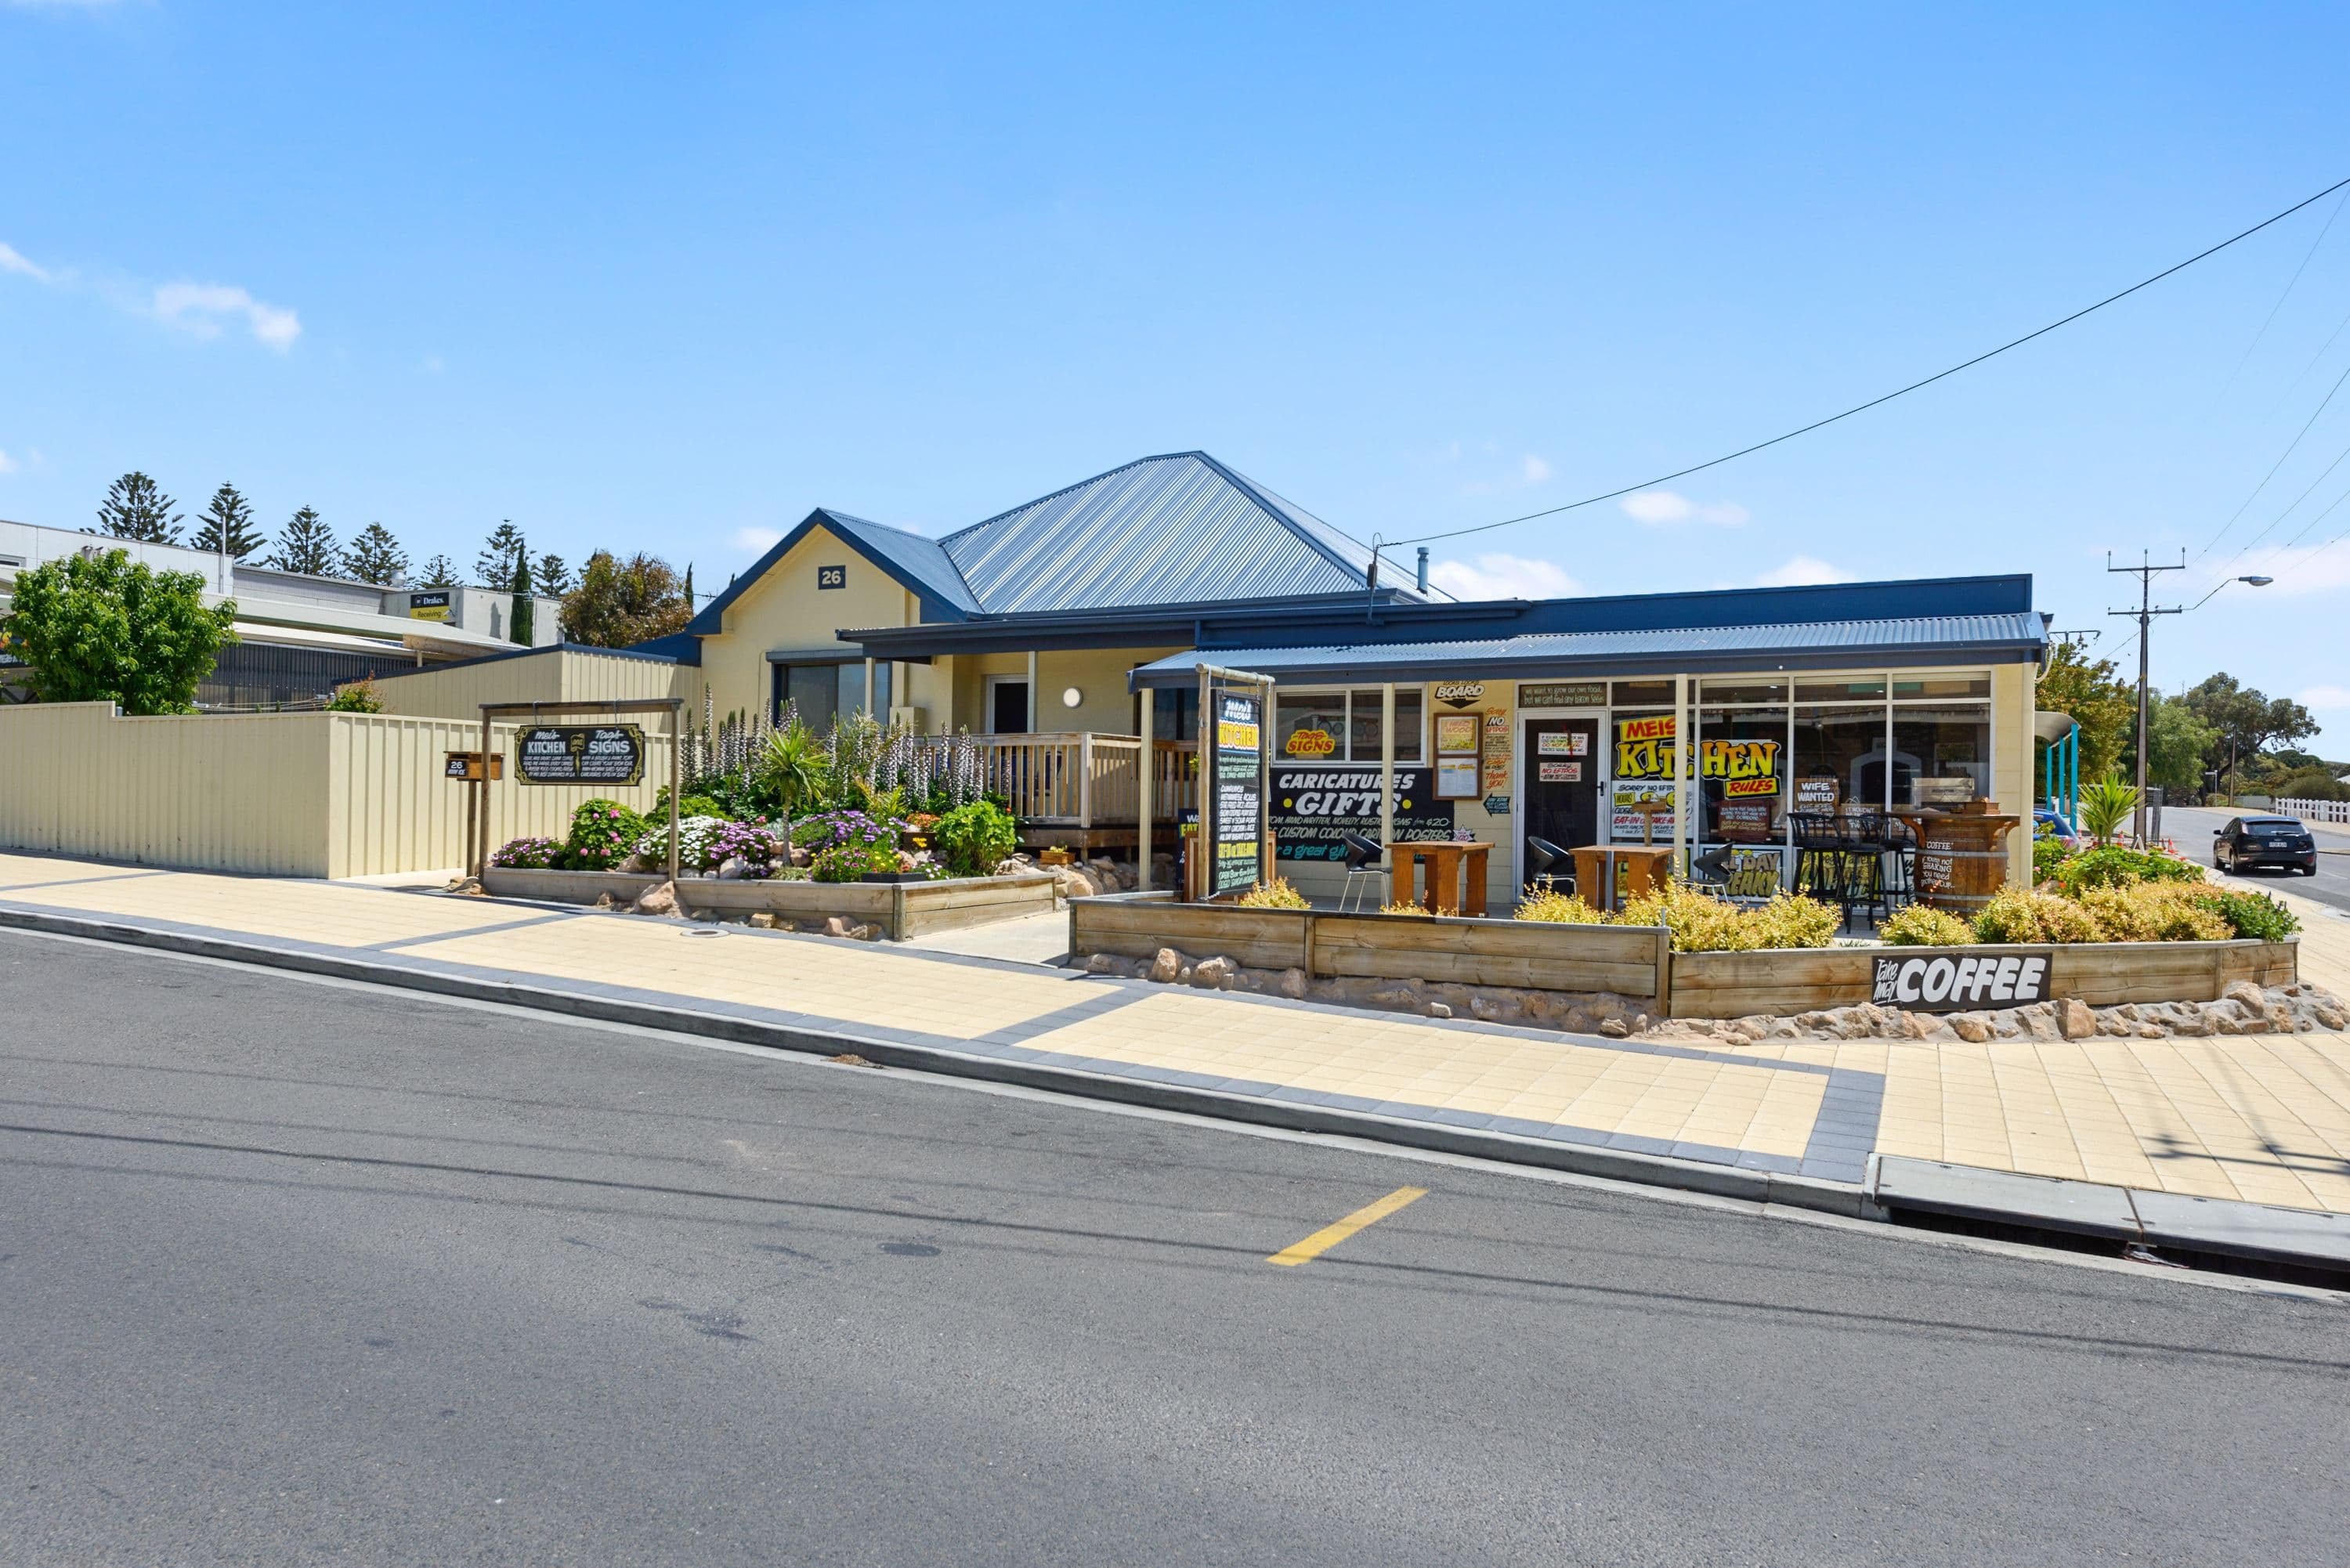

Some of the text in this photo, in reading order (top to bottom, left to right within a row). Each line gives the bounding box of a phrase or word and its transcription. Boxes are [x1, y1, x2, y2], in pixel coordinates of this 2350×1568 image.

[822, 570, 841, 584] 26
[423, 596, 444, 605] Drakes
[1434, 685, 1485, 699] BOARD
[1487, 717, 1505, 726] NO
[1218, 721, 1259, 750] KITCHEN
[527, 741, 566, 754] KITCHEN
[589, 740, 630, 754] SIGNS
[1287, 740, 1333, 752] SIGNS
[1278, 774, 1415, 789] CARICATURES
[1730, 779, 1773, 793] RULES
[1802, 782, 1831, 791] WIFE
[1295, 792, 1402, 816] GIFTS
[1798, 793, 1835, 802] WANTED
[1393, 818, 1412, 826] IGNS
[1278, 827, 1318, 838] CUSTOM
[1359, 828, 1405, 840] CARTN
[1405, 829, 1452, 840] POSTERS
[1282, 846, 1292, 855] a
[1294, 844, 1328, 859] great
[1743, 853, 1781, 871] DAY
[1923, 862, 1952, 873] SHAKING
[1933, 872, 1950, 880] need
[1706, 871, 1779, 898] EAKY
[1876, 959, 1899, 982] Take
[1896, 956, 2047, 1003] COFFEE
